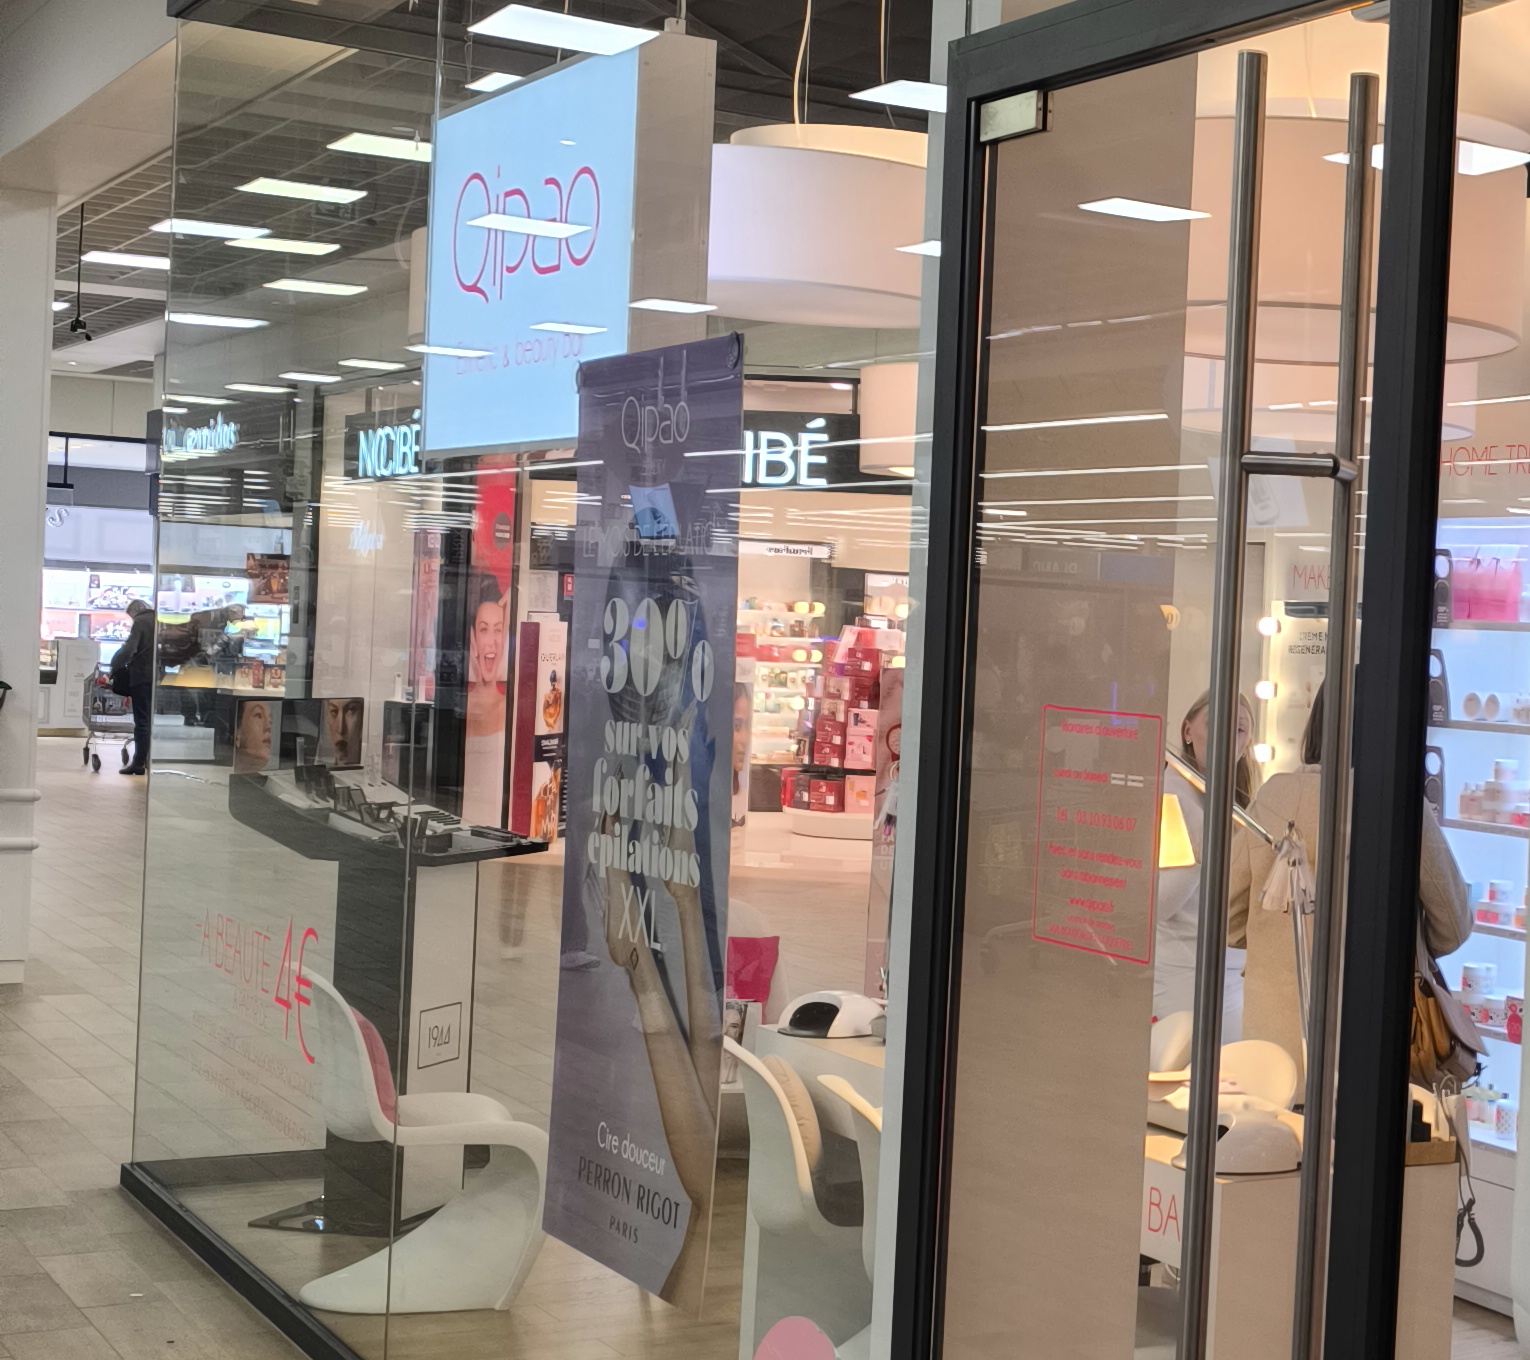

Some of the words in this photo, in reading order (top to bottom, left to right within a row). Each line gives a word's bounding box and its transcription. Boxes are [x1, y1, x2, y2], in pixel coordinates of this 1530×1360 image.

[621, 394, 690, 454] Qipao
[601, 597, 714, 704] 30%
[604, 719, 643, 757] sur
[649, 724, 690, 764] vos
[593, 757, 699, 832] forfaits
[587, 820, 701, 888] épilations
[274, 914, 319, 1065] 4€
[597, 1121, 619, 1155] Cire
[621, 1132, 665, 1177] douceur
[578, 1155, 633, 1205] PERRON
[636, 1183, 681, 1229] RIGOT
[609, 1214, 638, 1245] PARIS
